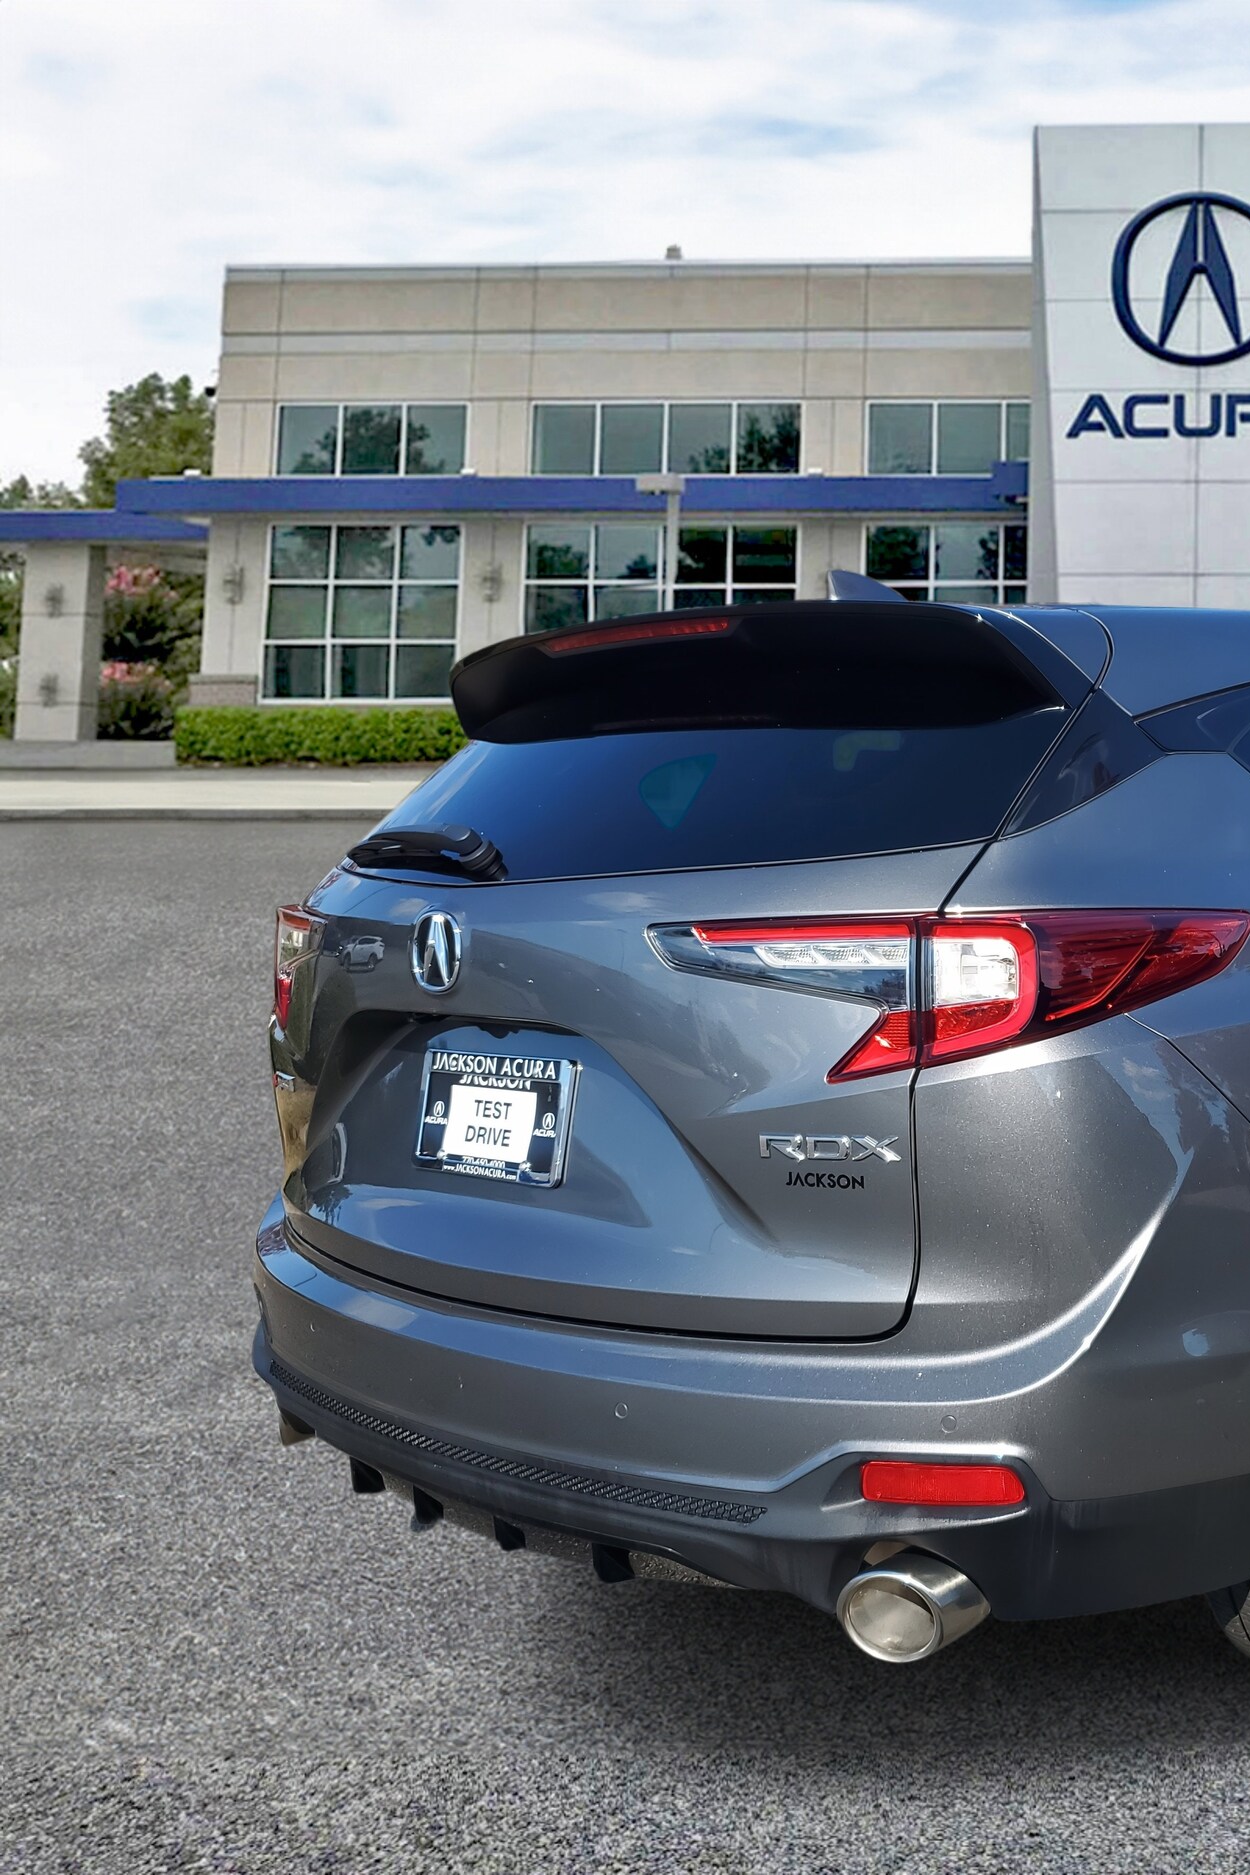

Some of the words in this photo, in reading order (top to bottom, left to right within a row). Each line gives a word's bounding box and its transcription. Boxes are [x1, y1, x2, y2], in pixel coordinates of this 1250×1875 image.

[433, 1052, 497, 1075] JACKSON
[500, 1058, 557, 1080] ACURA
[474, 1099, 512, 1120] TEST
[464, 1125, 512, 1147] DRIVE
[759, 1133, 902, 1163] RDX
[785, 1171, 865, 1190] JACKSON
